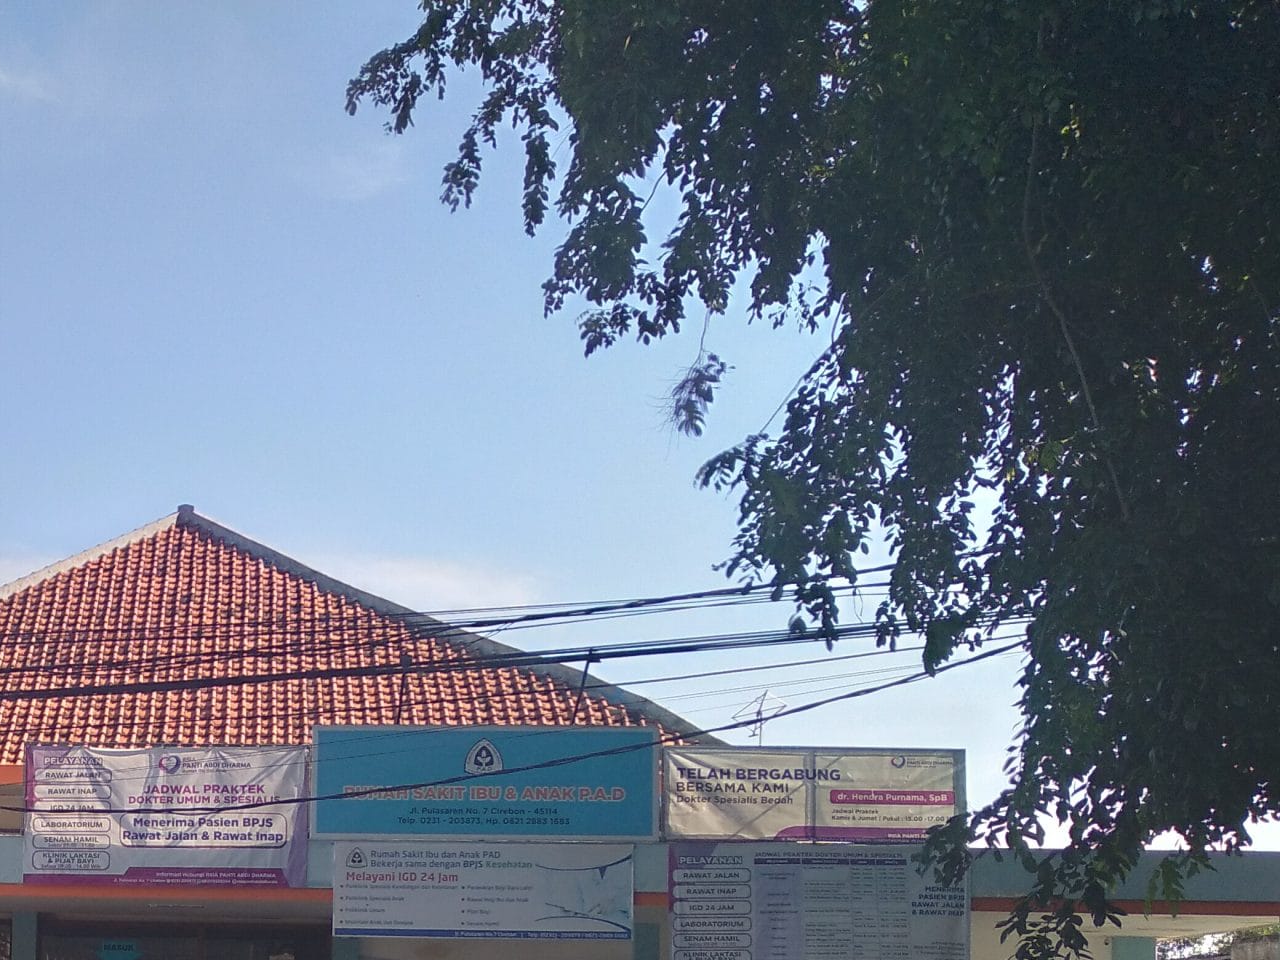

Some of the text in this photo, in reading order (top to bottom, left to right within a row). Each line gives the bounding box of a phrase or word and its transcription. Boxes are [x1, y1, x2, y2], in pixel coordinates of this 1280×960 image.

[44, 756, 104, 766] PELAYANAN
[676, 767, 841, 781] TELAH BERGABUNG
[144, 785, 265, 794] JADWAL PRAKTEK
[676, 782, 789, 793] BERSAMA KAMI
[412, 786, 466, 801] SAKIT
[469, 786, 502, 801] IBU
[504, 786, 517, 801] &
[522, 786, 574, 801] ANAK
[578, 787, 626, 802] P.A.D
[852, 793, 883, 801] Hendra
[886, 794, 927, 802] Purnama,
[929, 794, 948, 803] SpB
[128, 796, 174, 804] DOKTER
[177, 796, 210, 804] UMUM
[214, 796, 220, 804] &
[676, 795, 793, 805] Dokter Spesialis Bedah
[133, 818, 273, 828] Menerima Pasien BPJS
[123, 831, 284, 842] Rawat Jalan & Rawat Inap
[370, 850, 501, 859] Rumah Sakit Ibu dan Anak PAD
[370, 860, 404, 869] Bekerja
[429, 860, 461, 870] dengan
[463, 860, 483, 869] BPJS
[485, 860, 532, 869] Kesehatan
[679, 856, 743, 865] PELAYANAN
[346, 872, 395, 883] Melayani
[398, 872, 417, 882] IGD
[420, 872, 435, 882] 24
